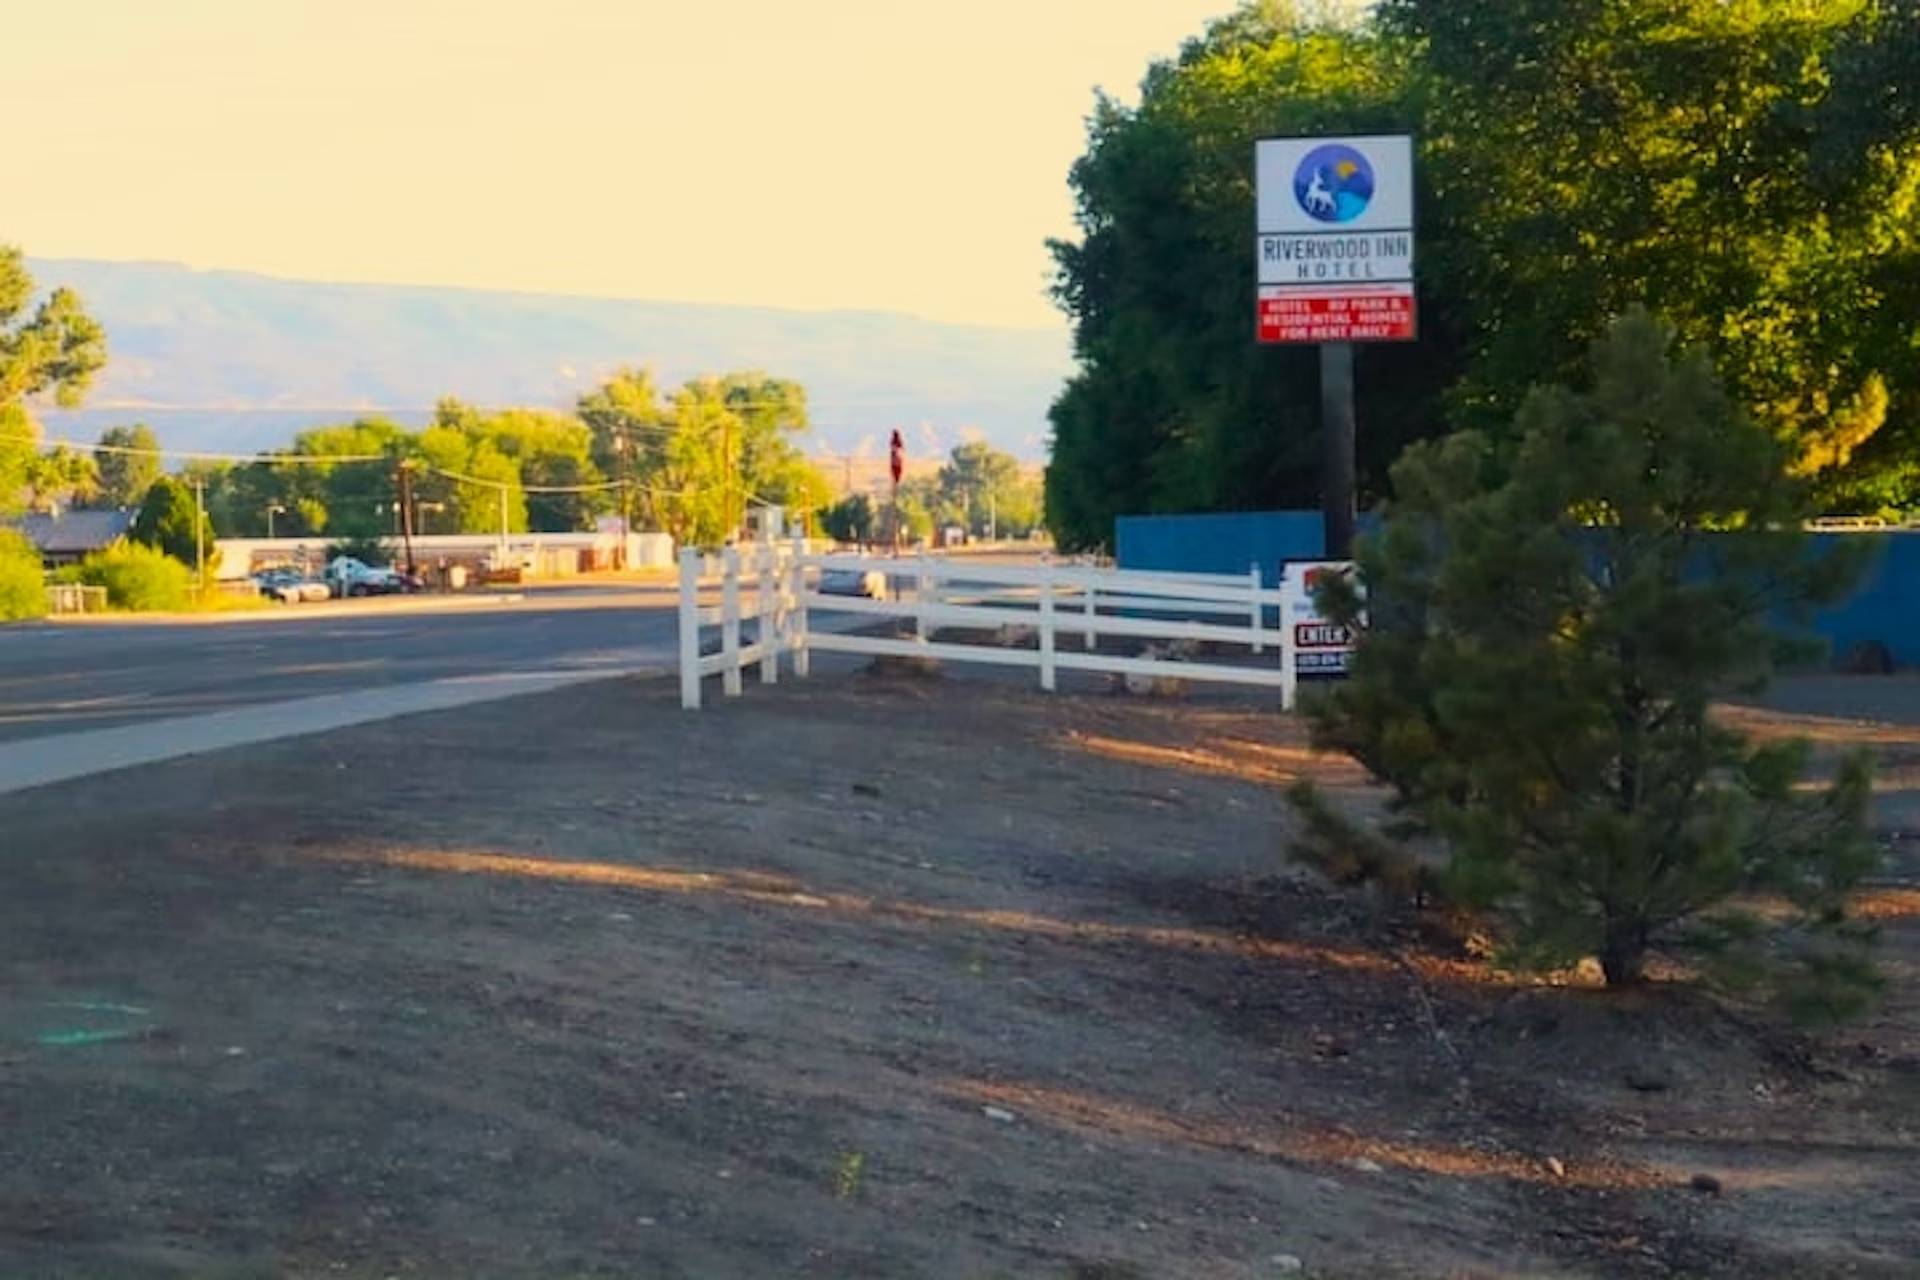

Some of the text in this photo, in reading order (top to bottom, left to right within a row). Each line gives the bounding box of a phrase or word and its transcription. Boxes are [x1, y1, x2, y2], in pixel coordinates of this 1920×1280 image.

[1264, 235, 1409, 262] RIVERWOOD INN
[1298, 262, 1374, 278] HOTEL
[1351, 298, 1387, 310] PARK
[1263, 310, 1409, 326] RESIDENTIAL HOMES
[1279, 324, 1390, 339] FOR RENT DAILY
